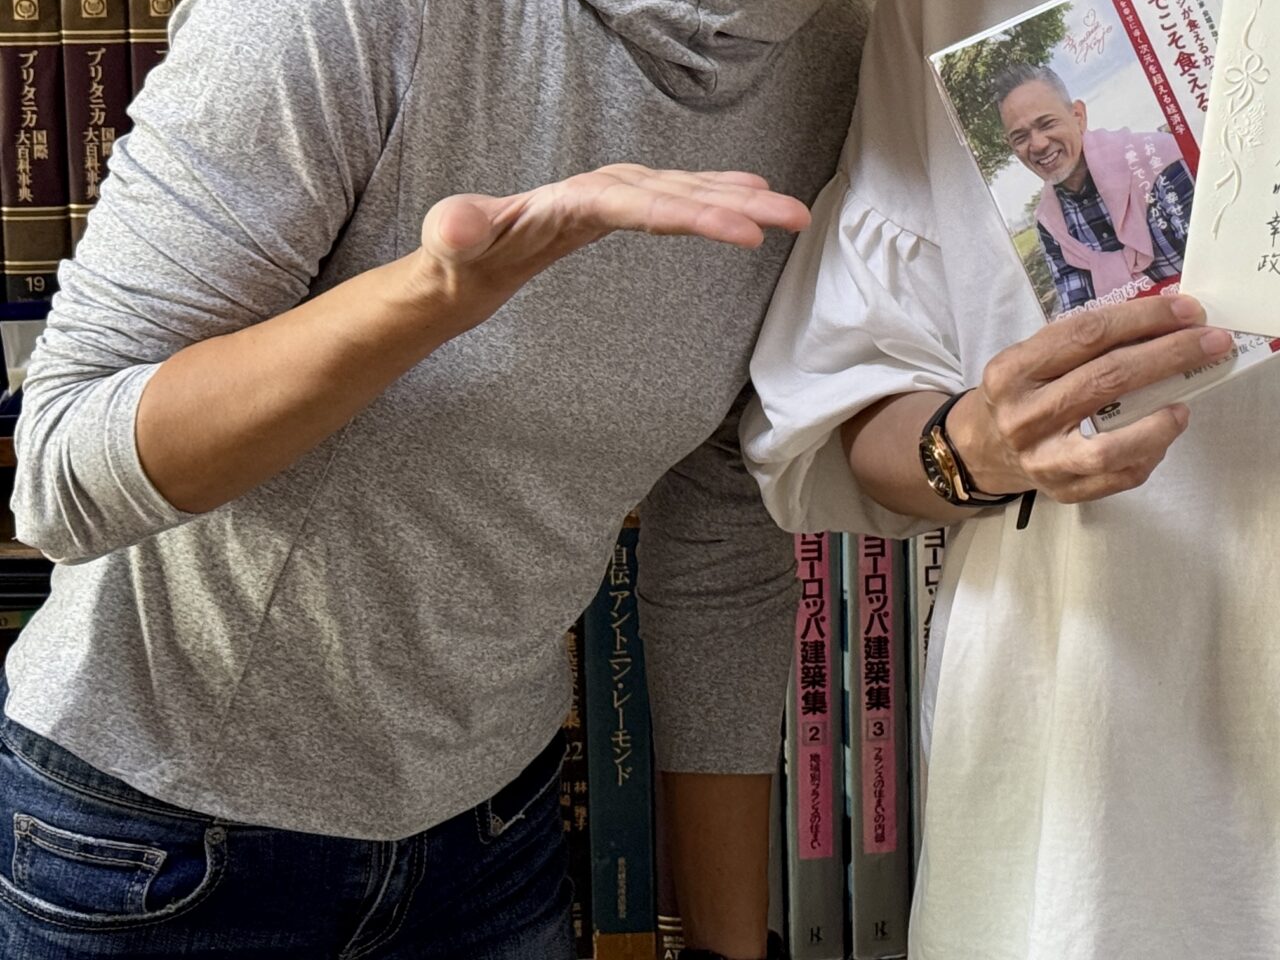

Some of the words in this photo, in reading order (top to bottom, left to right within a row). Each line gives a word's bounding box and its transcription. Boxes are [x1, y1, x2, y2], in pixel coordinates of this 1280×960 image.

[25, 276, 46, 292] 19
[1100, 409, 1122, 422] VIDEO
[607, 589, 634, 787] アントニン・レーモンド
[808, 726, 821, 742] 2
[872, 721, 885, 737] 3
